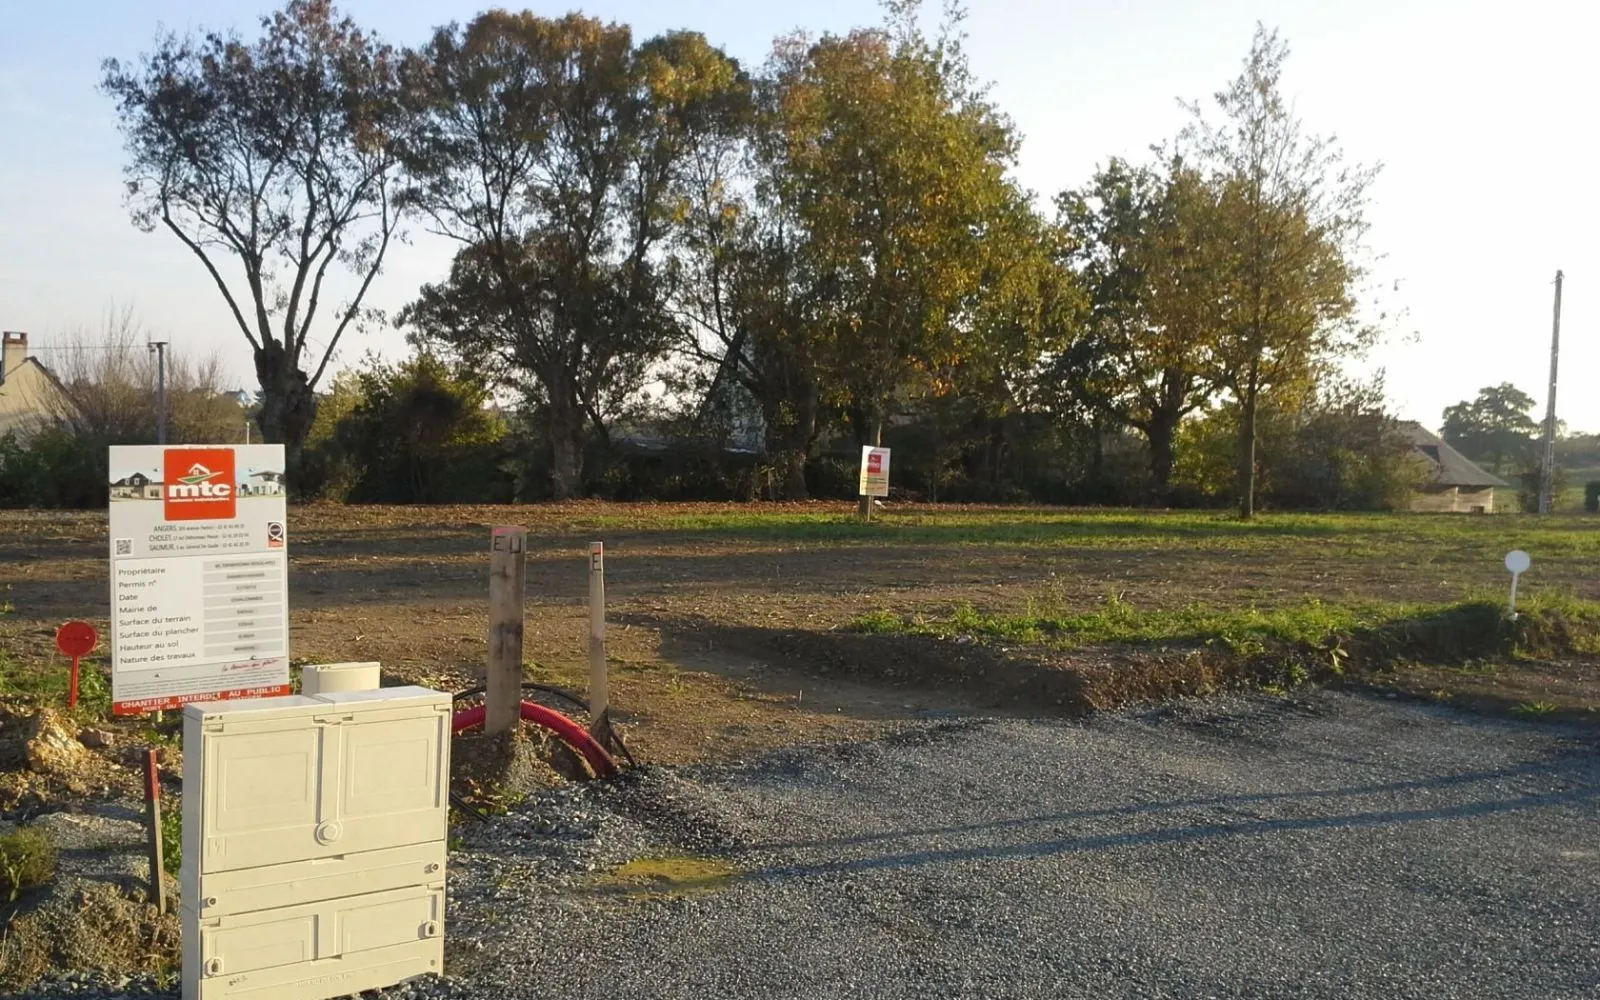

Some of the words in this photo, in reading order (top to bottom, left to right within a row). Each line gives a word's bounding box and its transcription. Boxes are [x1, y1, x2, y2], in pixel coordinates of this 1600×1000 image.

[169, 481, 231, 497] mtc
[118, 567, 165, 576] Propriétaire
[118, 580, 146, 588] Permis
[119, 593, 138, 601] Date
[119, 606, 144, 614] Mairie
[119, 619, 149, 627] Surface
[165, 615, 191, 623] terrain
[119, 631, 149, 639] Surface
[165, 627, 199, 637] plancher
[119, 643, 152, 651] Hauteur
[167, 639, 179, 647] sol
[120, 656, 148, 664] Nature
[150, 654, 165, 662] des
[167, 651, 196, 660] travaux
[121, 697, 170, 709] CHANTIER
[177, 692, 221, 704] INTERDT
[228, 690, 241, 698] AU
[246, 686, 281, 696] PUBLIC
